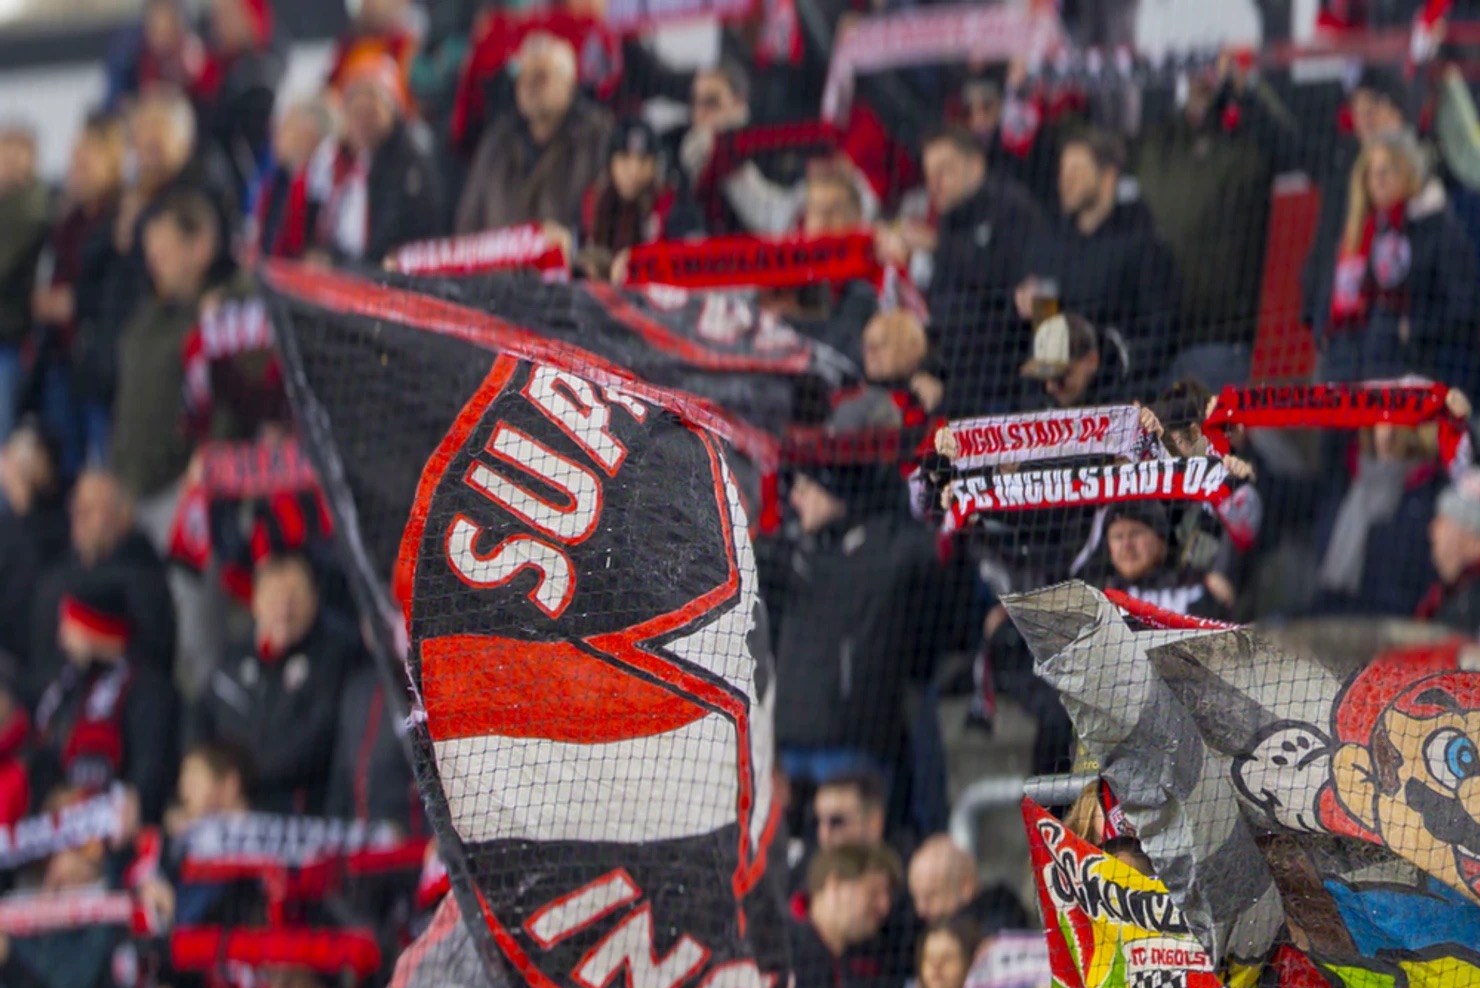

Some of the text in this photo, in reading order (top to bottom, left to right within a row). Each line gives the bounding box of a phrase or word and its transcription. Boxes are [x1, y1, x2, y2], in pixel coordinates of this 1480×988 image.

[1078, 415, 1110, 443] 04
[954, 456, 1229, 515] FC INGOLSTADT 04
[1151, 947, 1214, 967] INGOLS
